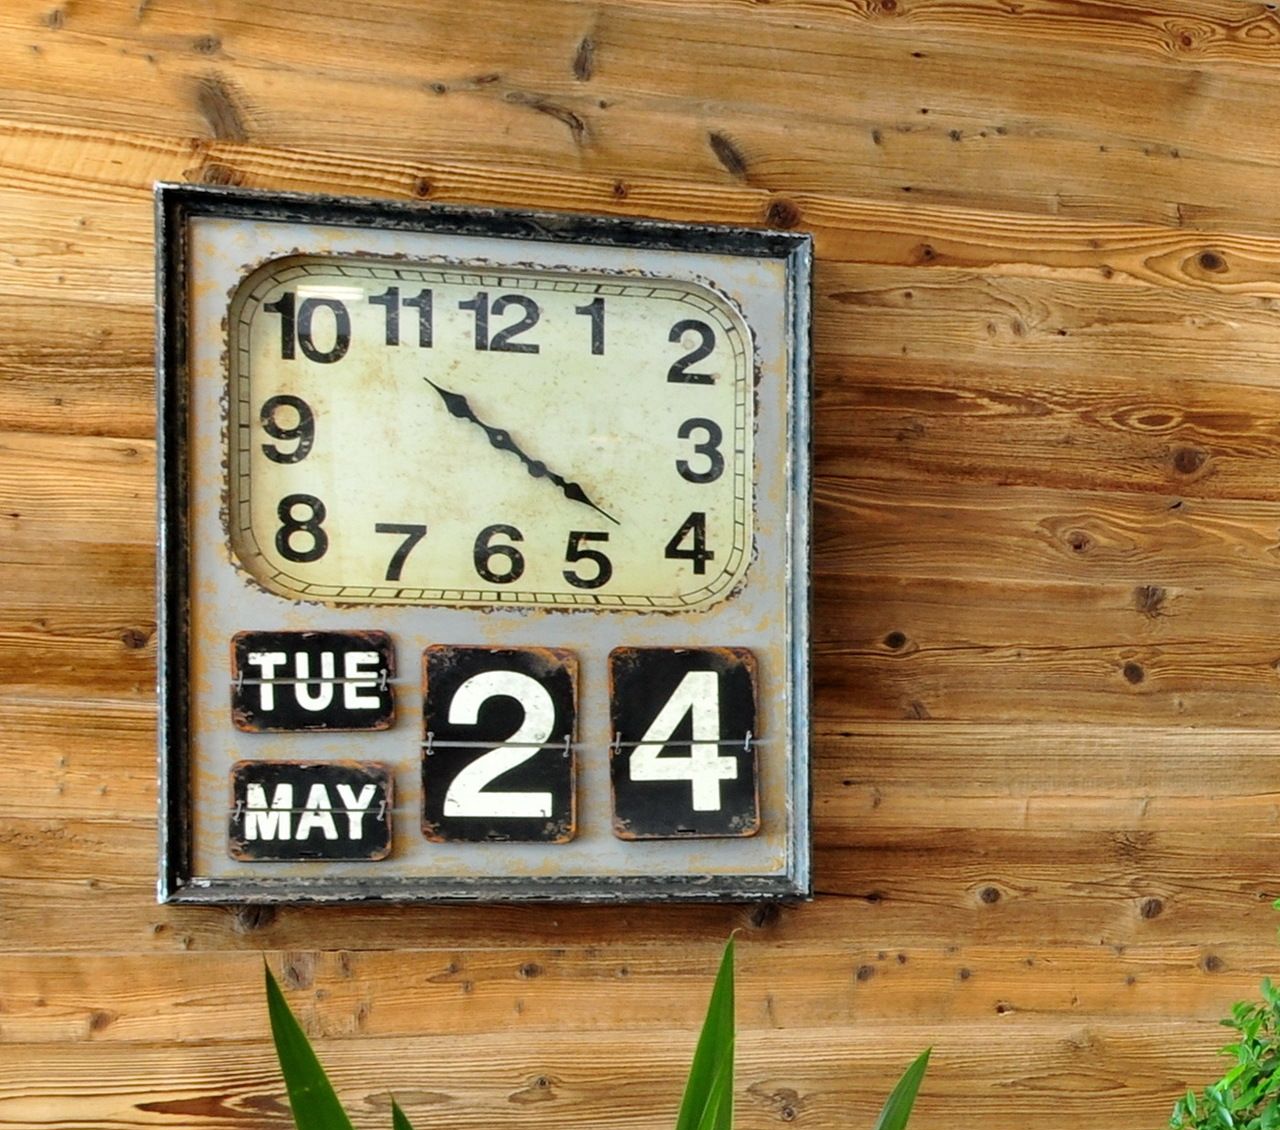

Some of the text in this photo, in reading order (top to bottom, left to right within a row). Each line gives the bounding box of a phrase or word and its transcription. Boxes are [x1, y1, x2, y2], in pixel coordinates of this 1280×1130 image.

[264, 292, 351, 364] 10
[369, 287, 433, 348] 11
[458, 291, 540, 354] 12
[575, 297, 605, 356] 1
[667, 319, 716, 385] 2
[260, 395, 315, 464] 9
[676, 417, 724, 484] 3
[275, 494, 328, 563] 8
[375, 523, 427, 581] 7
[474, 524, 525, 584] 6
[665, 512, 714, 575] 4
[563, 531, 612, 589] 5
[248, 651, 382, 713] TUE
[244, 782, 378, 842] MAY
